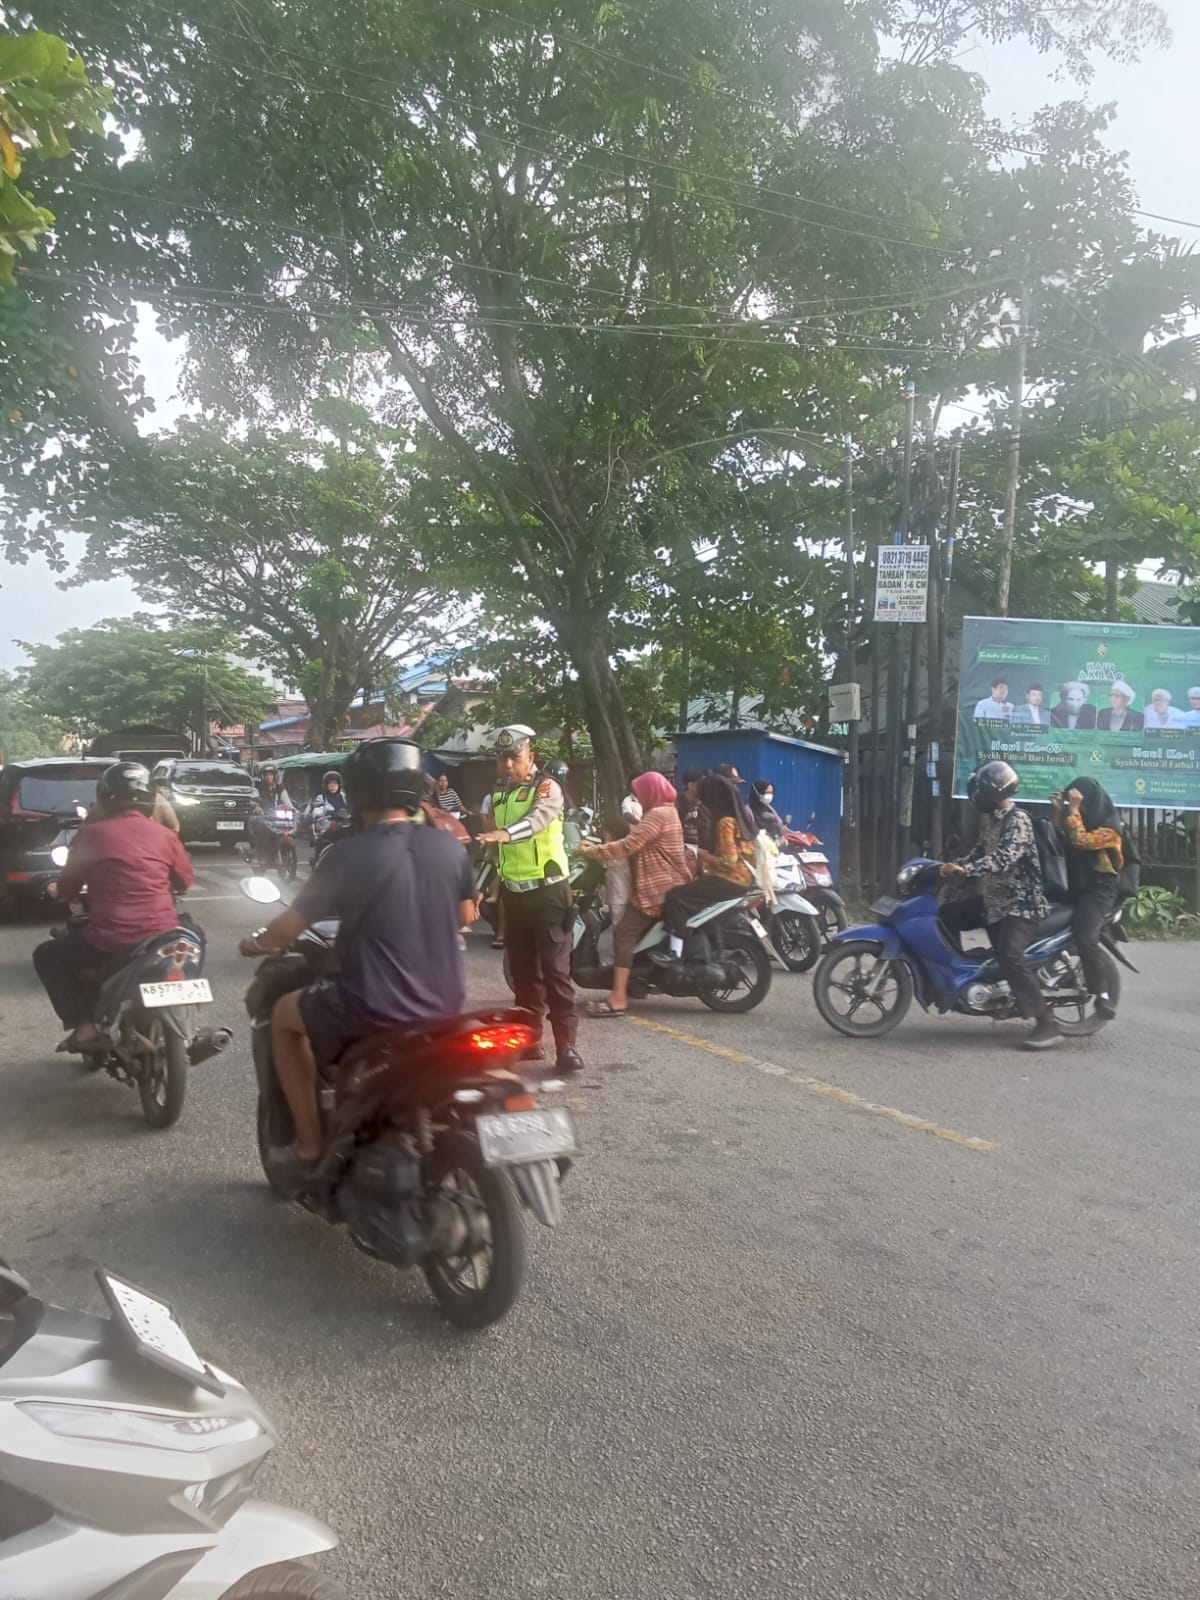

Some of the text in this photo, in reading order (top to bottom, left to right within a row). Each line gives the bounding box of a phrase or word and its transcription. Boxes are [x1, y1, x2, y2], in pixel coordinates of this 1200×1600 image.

[882, 552, 897, 564] 0821
[880, 570, 928, 580] TAMBAH TINGGI
[916, 580, 927, 588] CM
[1086, 662, 1116, 671] HAUL
[1078, 670, 1125, 681] AKBAR
[991, 740, 1020, 752] Haul
[978, 752, 1001, 760] Syekh
[1003, 752, 1027, 760] Fathul
[1089, 750, 1102, 764] &
[1132, 747, 1163, 758] Haul
[1115, 758, 1139, 768] Syekh
